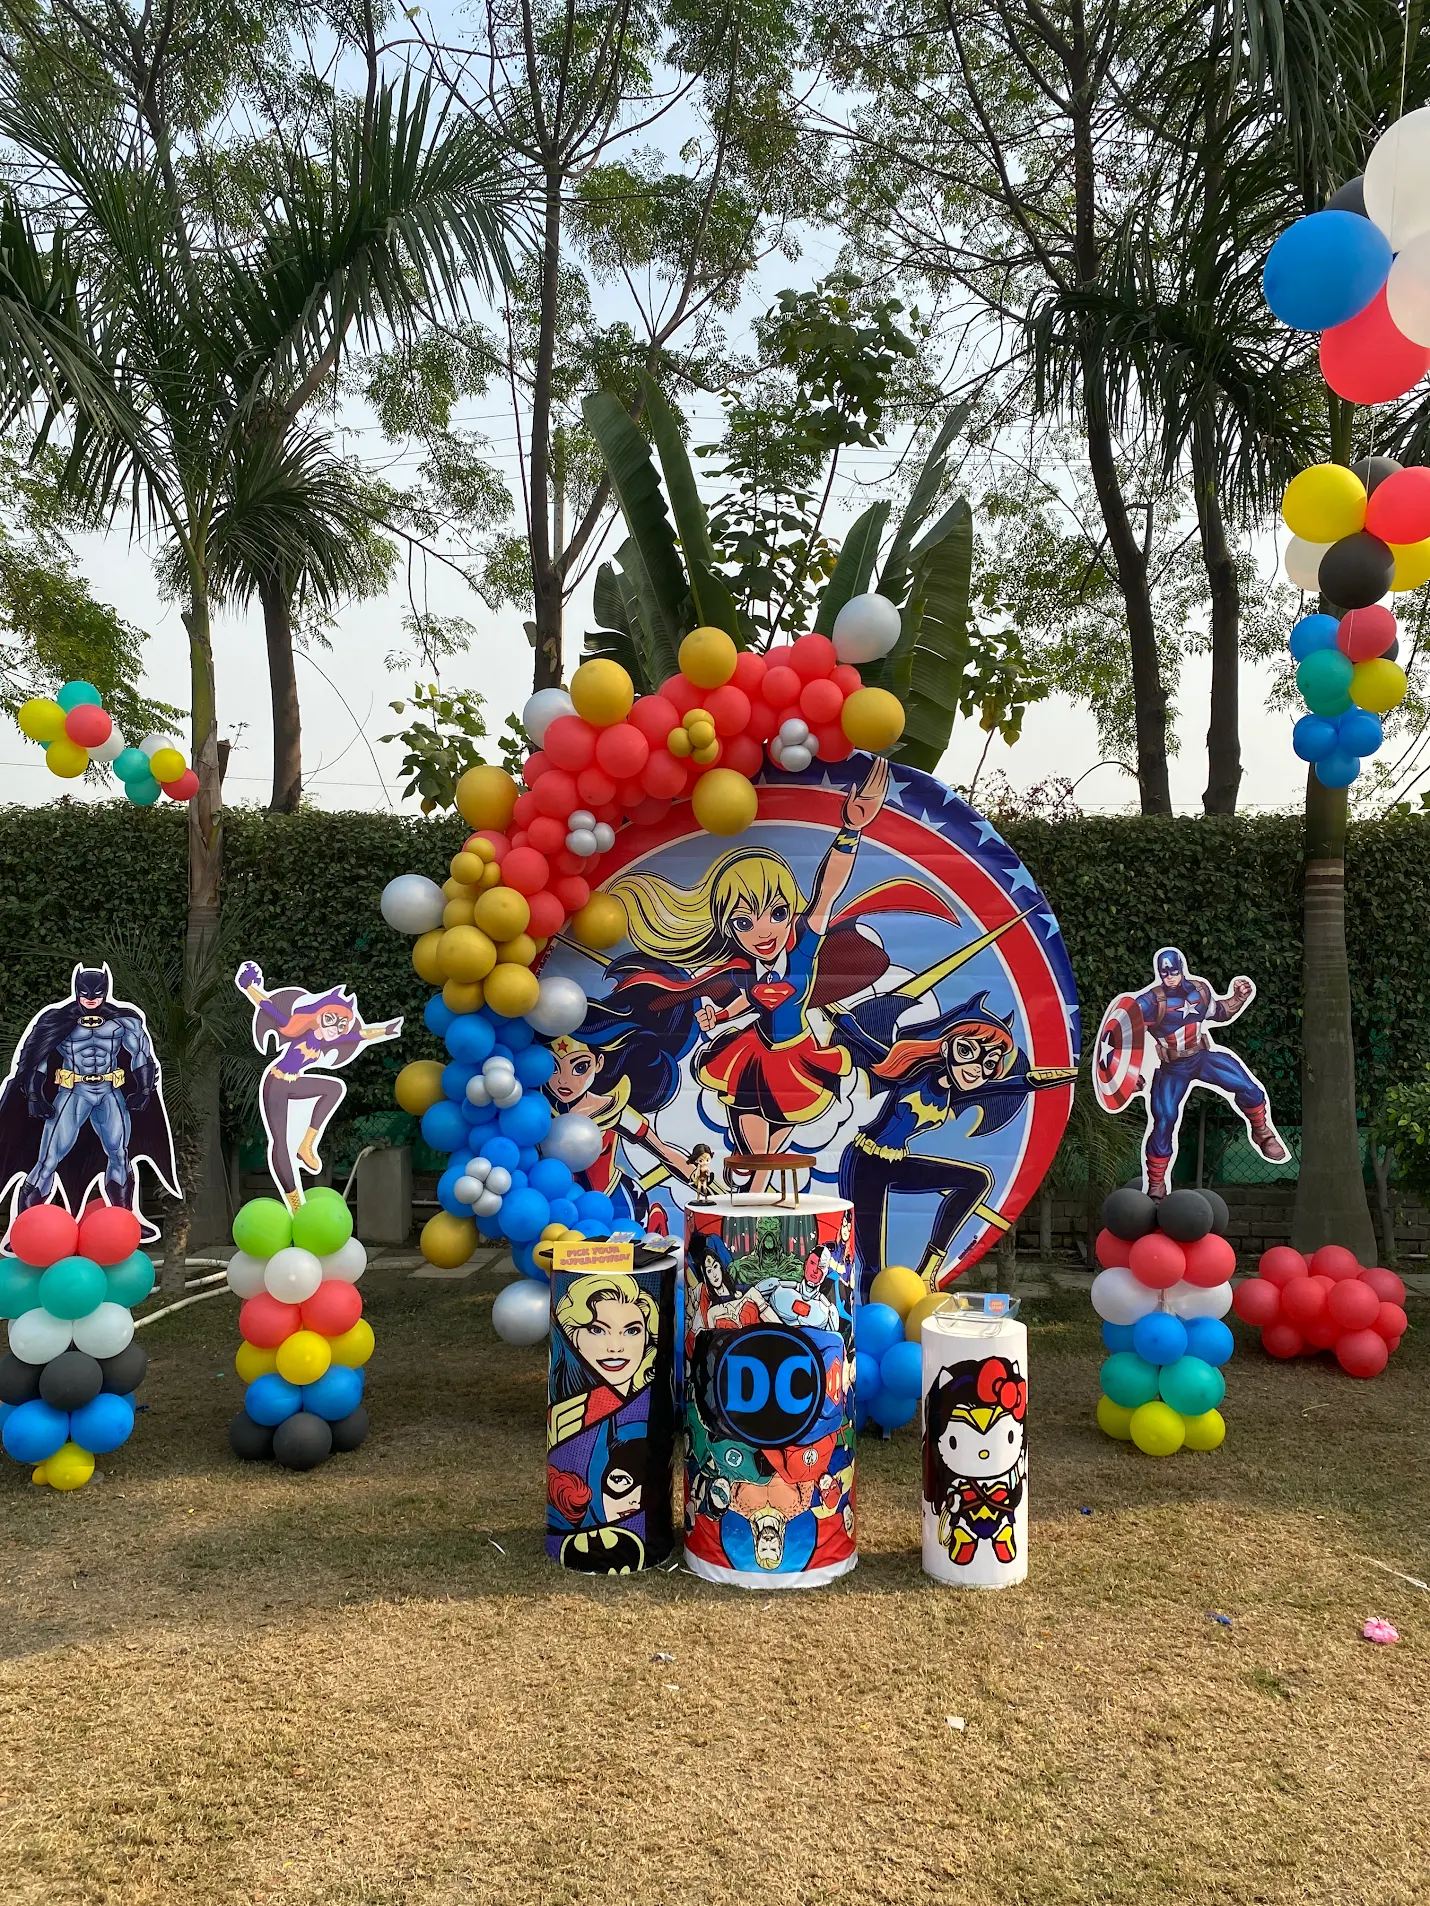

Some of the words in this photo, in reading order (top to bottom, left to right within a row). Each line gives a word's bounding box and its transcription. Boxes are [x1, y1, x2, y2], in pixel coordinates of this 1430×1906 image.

[567, 1248, 590, 1257] PICK
[592, 1246, 620, 1255] YOUR
[560, 1253, 630, 1265] SUPERPOWER!
[725, 1355, 814, 1415] DC
